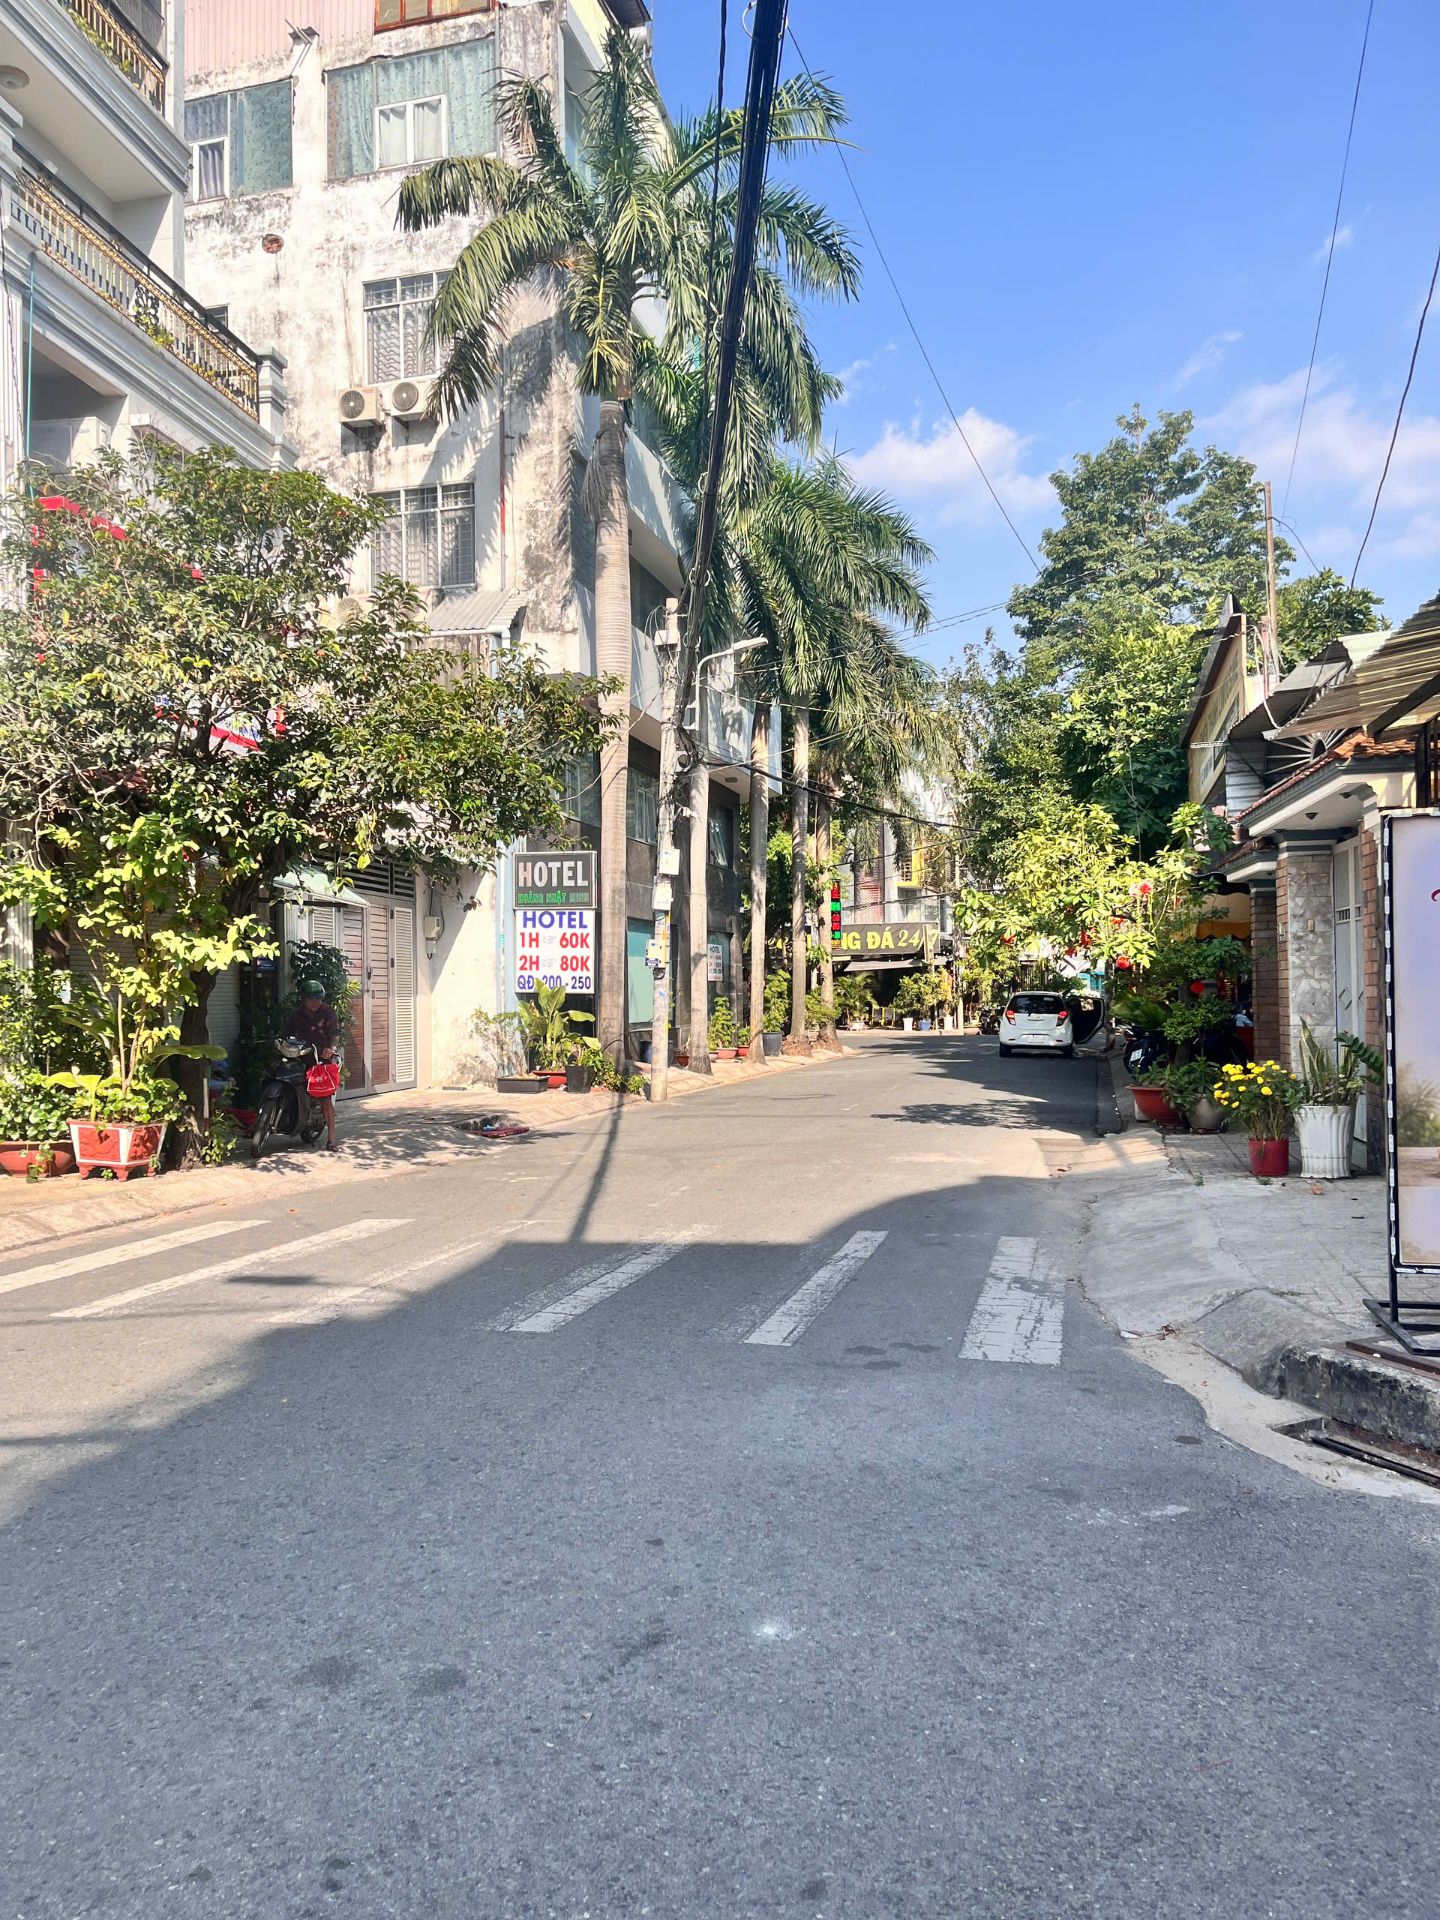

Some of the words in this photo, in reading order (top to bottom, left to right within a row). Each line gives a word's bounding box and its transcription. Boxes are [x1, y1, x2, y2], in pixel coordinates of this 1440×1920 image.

[518, 860, 589, 888] HOTEL
[517, 890, 544, 904] HOÀNG
[546, 890, 567, 905] NHẬT
[522, 910, 588, 929] HOTEL
[519, 931, 540, 948] 1H
[559, 931, 590, 949] 60K
[866, 927, 895, 950] ĐÁ
[518, 954, 540, 971] 2H
[559, 954, 591, 972] 80K
[517, 974, 535, 990] QĐ
[541, 974, 562, 990] 200
[571, 975, 592, 990] 250
